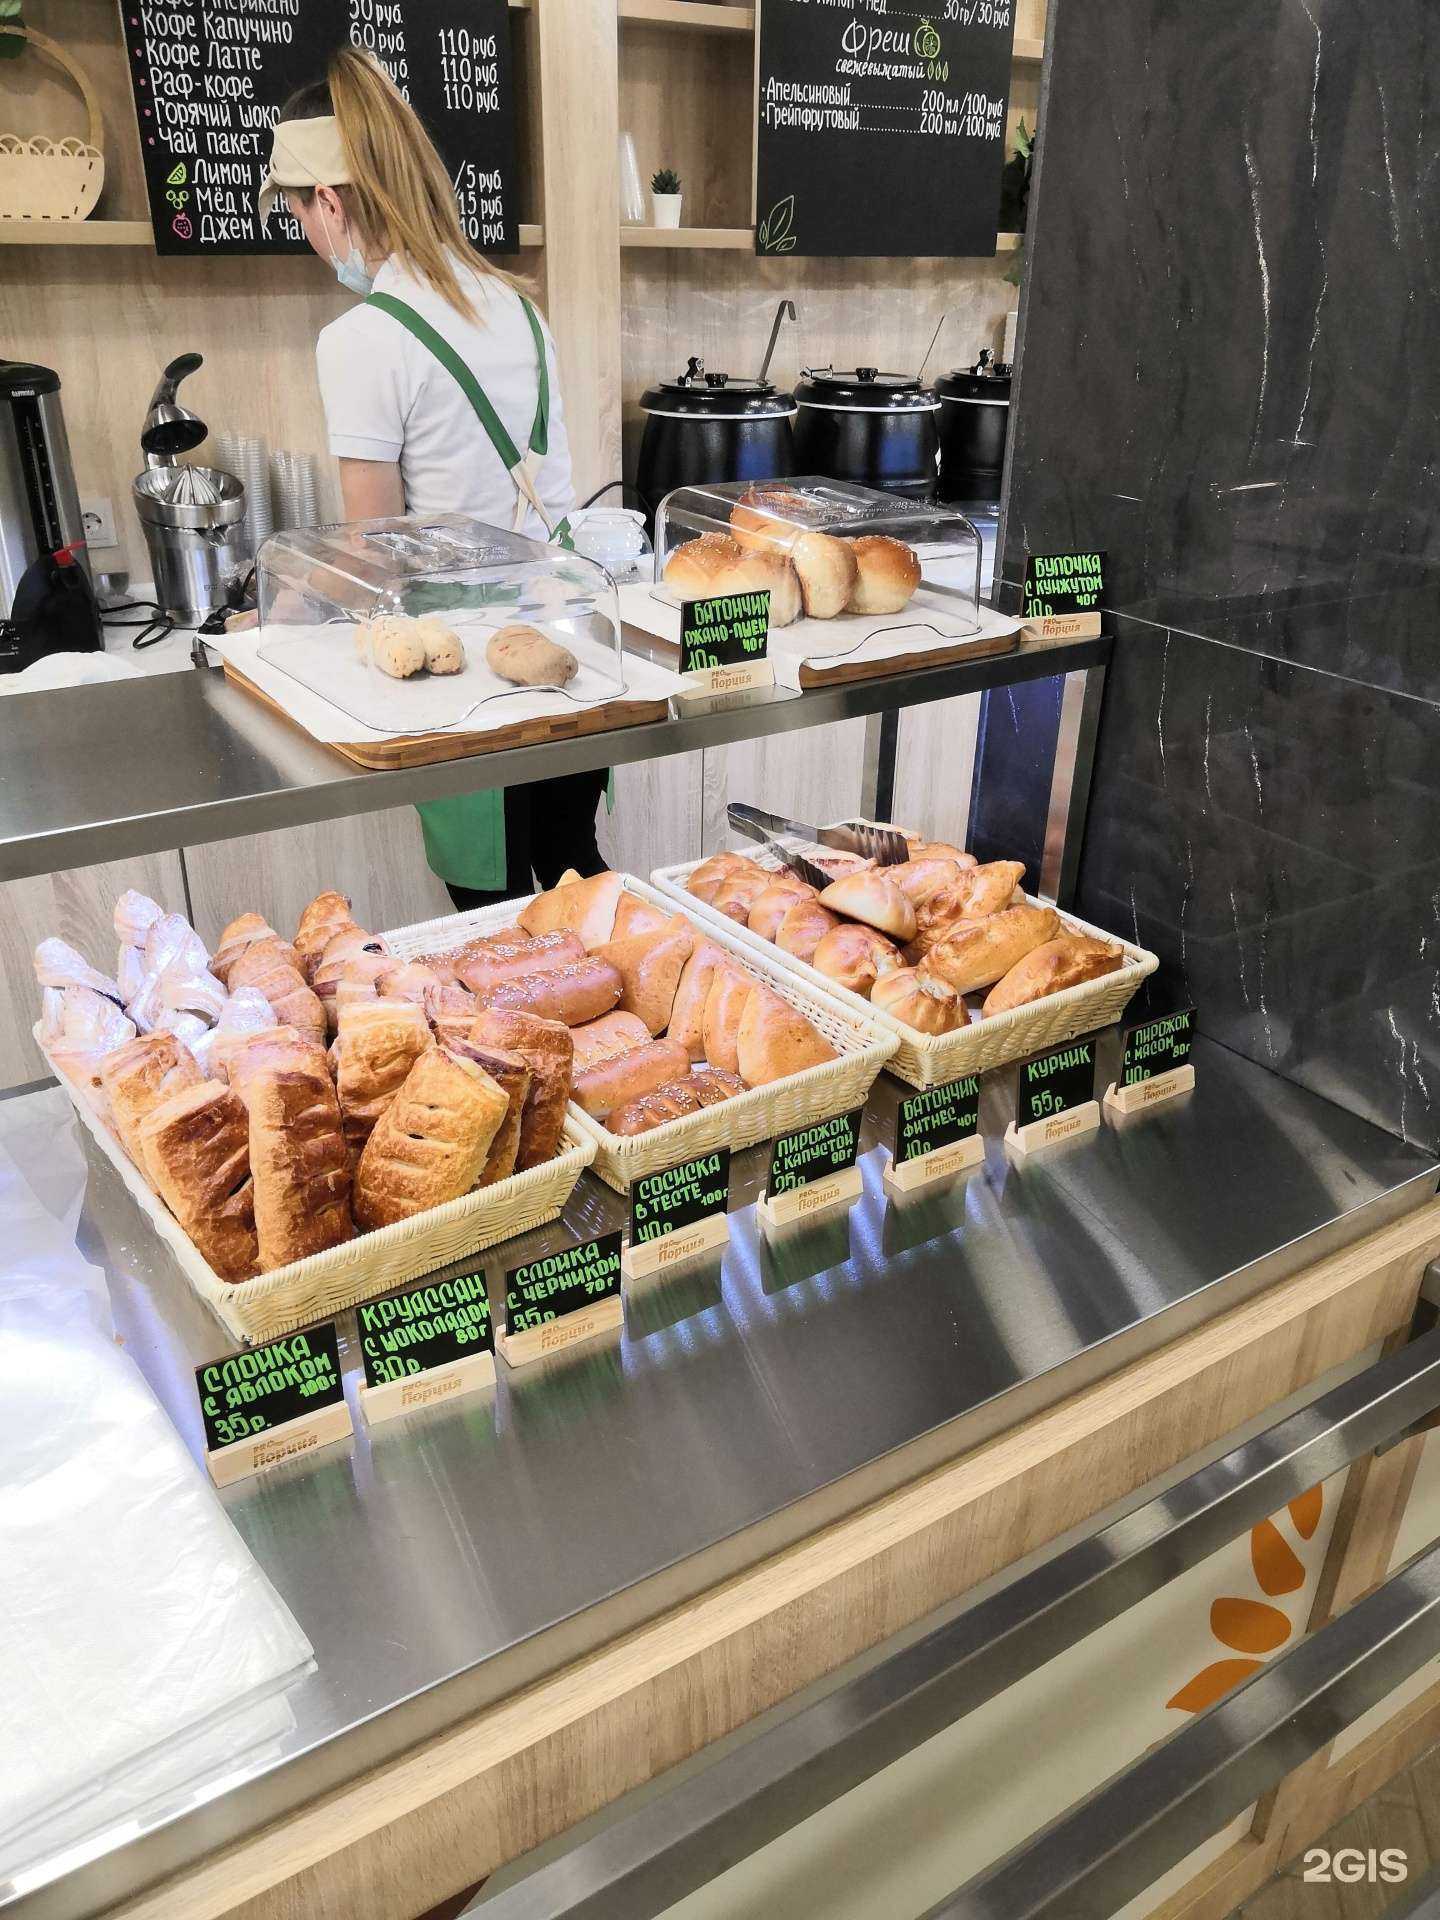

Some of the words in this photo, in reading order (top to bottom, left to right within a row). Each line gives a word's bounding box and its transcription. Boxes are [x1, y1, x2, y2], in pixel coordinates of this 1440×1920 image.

[141, 7, 197, 40] Кофе
[203, 11, 293, 44] Капучино
[350, 22, 376, 49] 60
[378, 32, 406, 54] руб.
[842, 17, 910, 61] Фреш
[145, 38, 200, 70] Кофе
[207, 42, 263, 71] Латте
[438, 28, 470, 56] 110
[472, 35, 498, 60] руб.
[441, 57, 472, 83] 110
[475, 63, 500, 87] руб.
[836, 59, 926, 80] свежевыжатый
[153, 98, 232, 129] Горячий
[443, 83, 473, 110] 110
[476, 87, 500, 113] руб.
[767, 77, 852, 106] Апельсиновый
[921, 90, 945, 112] 200
[767, 102, 860, 132] Грейпфрутовый
[920, 112, 943, 135] 200
[159, 127, 198, 154] Чай
[192, 158, 252, 186] Лимон
[479, 169, 502, 193] руб.
[196, 187, 238, 214] Мёд
[242, 194, 253, 214] к
[200, 214, 254, 244] Джем
[261, 220, 273, 240] к
[482, 221, 505, 246] руб.
[1035, 554, 1102, 578] БУЛОЧКА
[1036, 575, 1104, 596] КУНЖУТОМ
[694, 592, 771, 626] БАТОНЧИК
[1135, 1012, 1190, 1046] ПИРОЖОК
[1027, 1045, 1092, 1082] КУРНИК
[1134, 1035, 1175, 1061] МЯСОМ
[903, 1076, 980, 1121] БАТОНЧИК
[777, 1114, 851, 1158] ПИРОЖОК
[903, 1106, 957, 1138] ФИТНЕС
[784, 1131, 854, 1170] КАПУСТОЙ
[638, 1153, 721, 1200] СОСИСКА
[648, 1181, 702, 1214] ТЕСТЕ
[515, 1241, 601, 1287] СЛОЙКА
[522, 1251, 621, 1302] ЧЕРНИКОЙ
[360, 1274, 486, 1332] КРУАССАН
[379, 1298, 491, 1353] ШОКОЛАДОМ
[203, 1334, 312, 1394] СЛОЙКА
[225, 1352, 333, 1410] ЯБЛОКОМ
